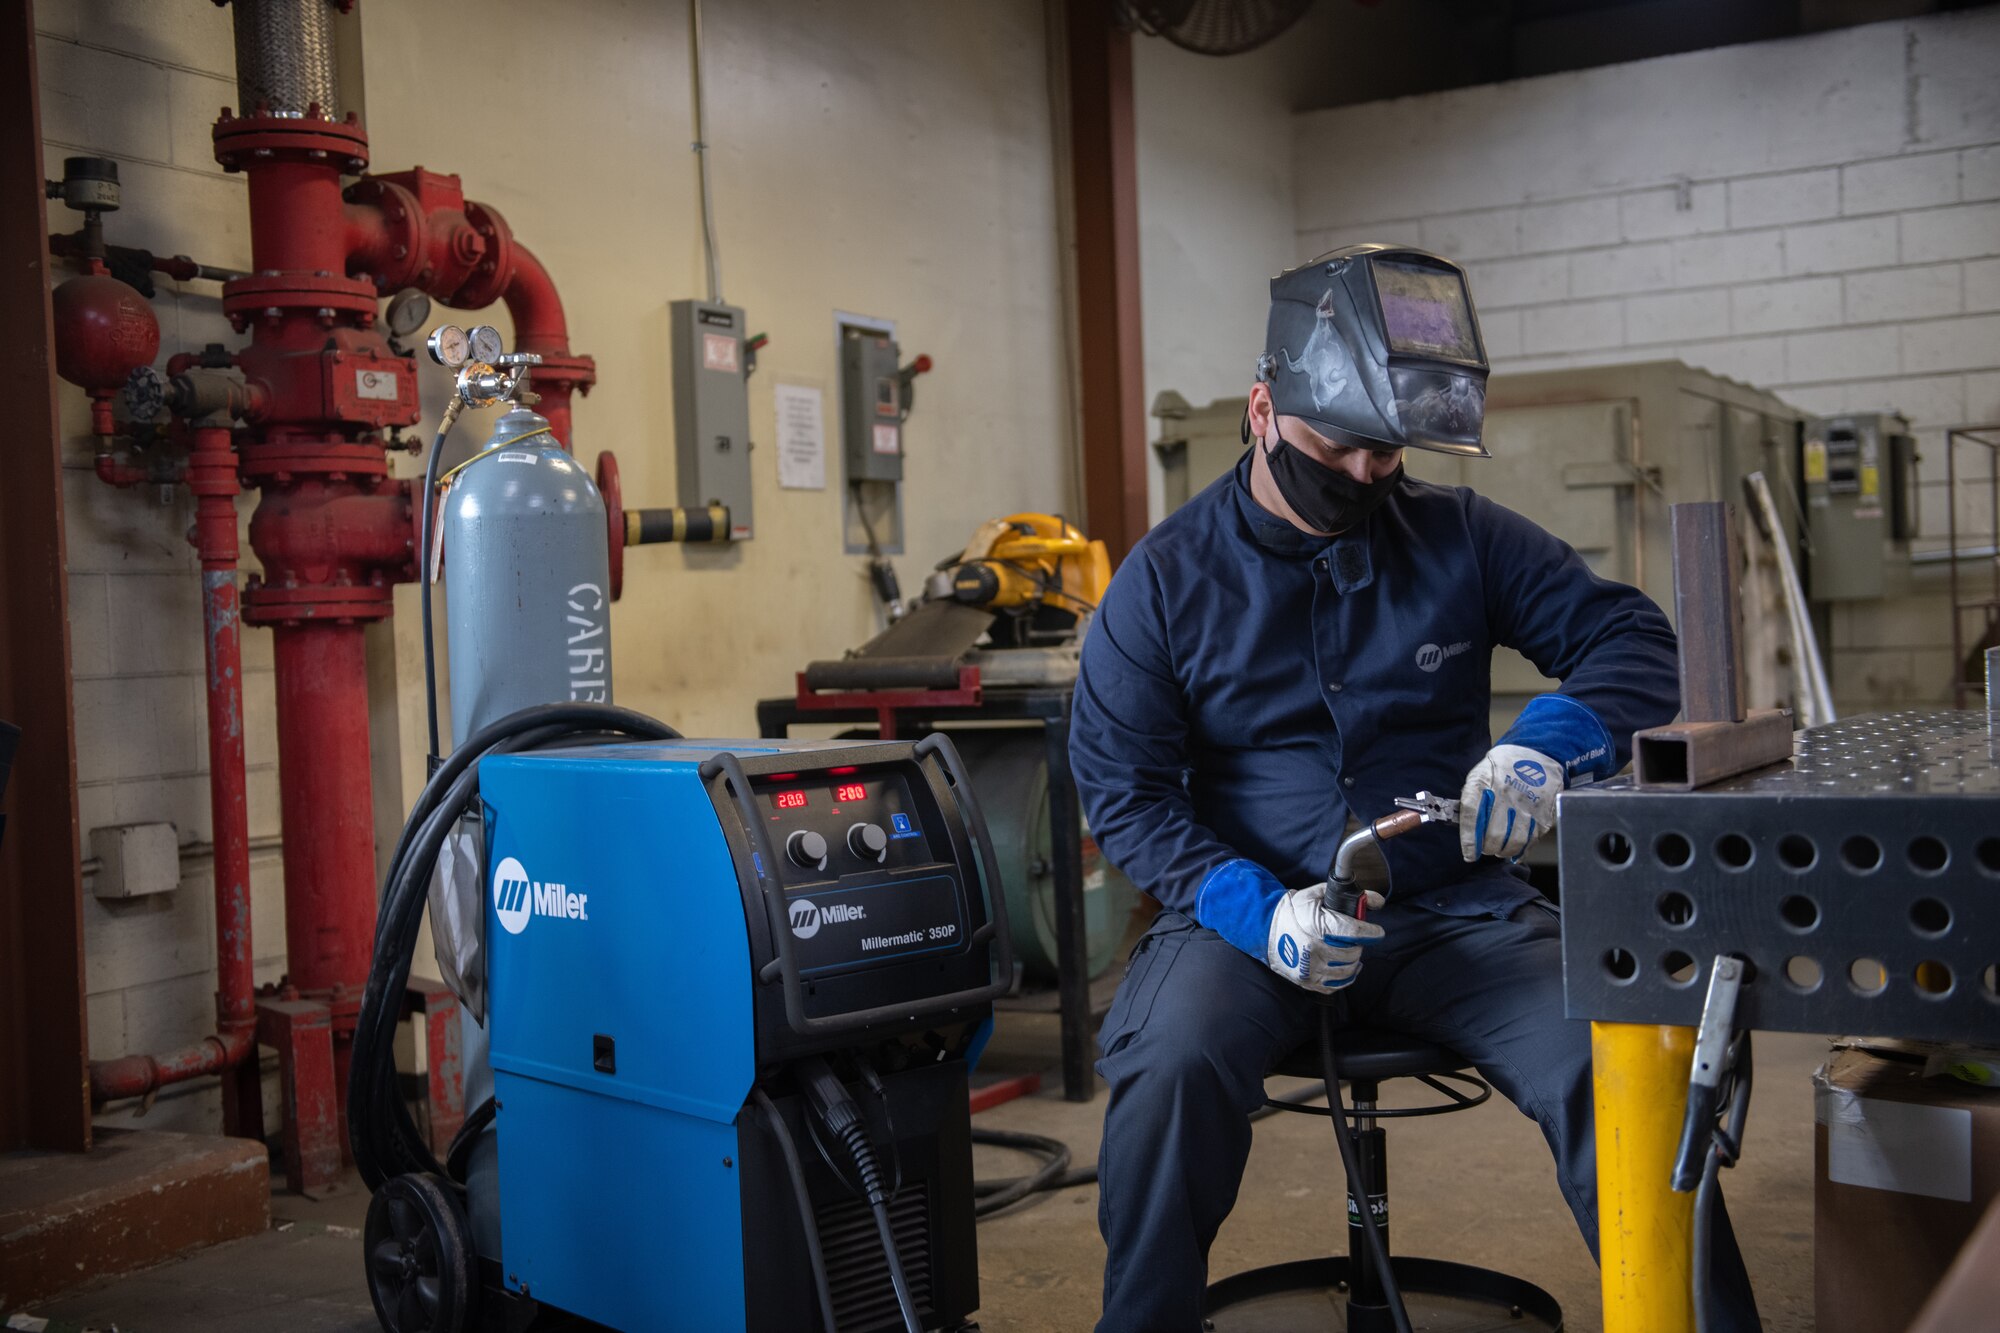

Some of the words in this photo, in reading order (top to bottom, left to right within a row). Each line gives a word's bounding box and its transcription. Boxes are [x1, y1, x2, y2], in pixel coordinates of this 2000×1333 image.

[1442, 641, 1471, 659] Miller
[1581, 752, 1590, 762] of
[838, 786, 864, 801] 200
[1504, 774, 1540, 803] Miller
[533, 881, 588, 920] Miller
[822, 904, 865, 925] Miller
[861, 930, 924, 951] Millermatic
[928, 924, 956, 941] 350P
[1299, 944, 1311, 979] Miller
